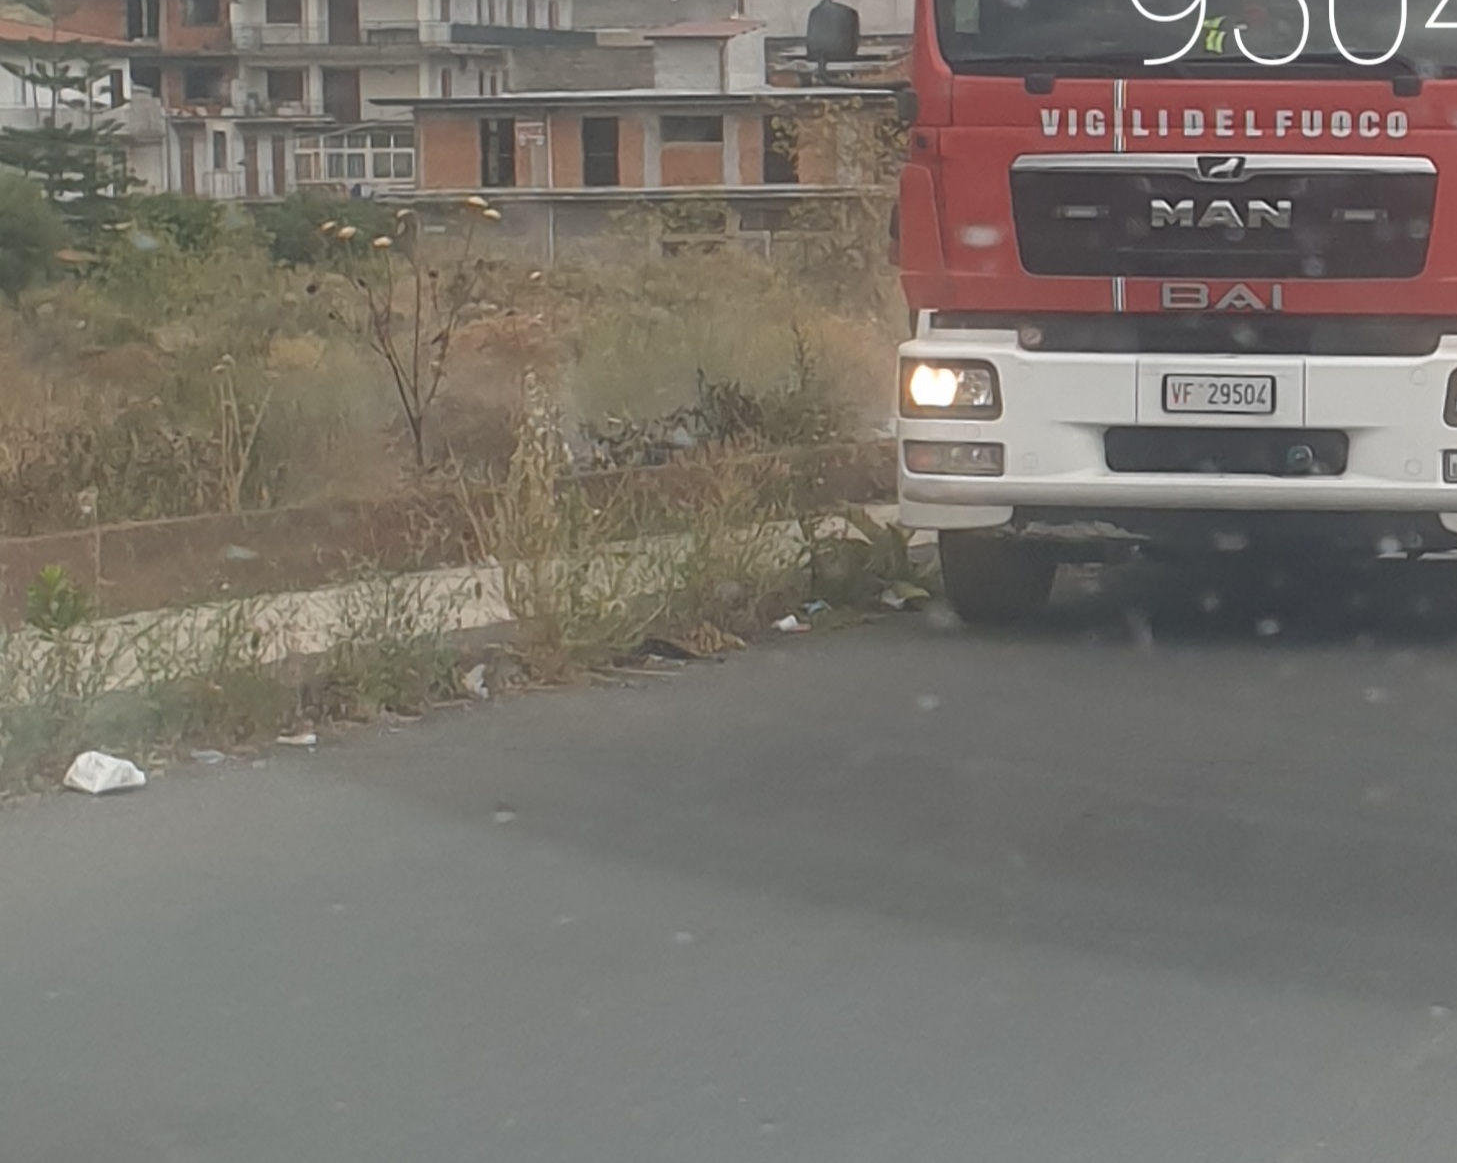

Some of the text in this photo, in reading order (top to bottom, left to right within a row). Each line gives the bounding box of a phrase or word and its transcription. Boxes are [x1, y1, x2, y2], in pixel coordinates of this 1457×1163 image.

[1039, 108, 1409, 138] VIGILI DEL FUOCO
[1150, 199, 1292, 228] MAN
[1162, 282, 1282, 310] BAI
[1171, 382, 1267, 405] VF 29504
